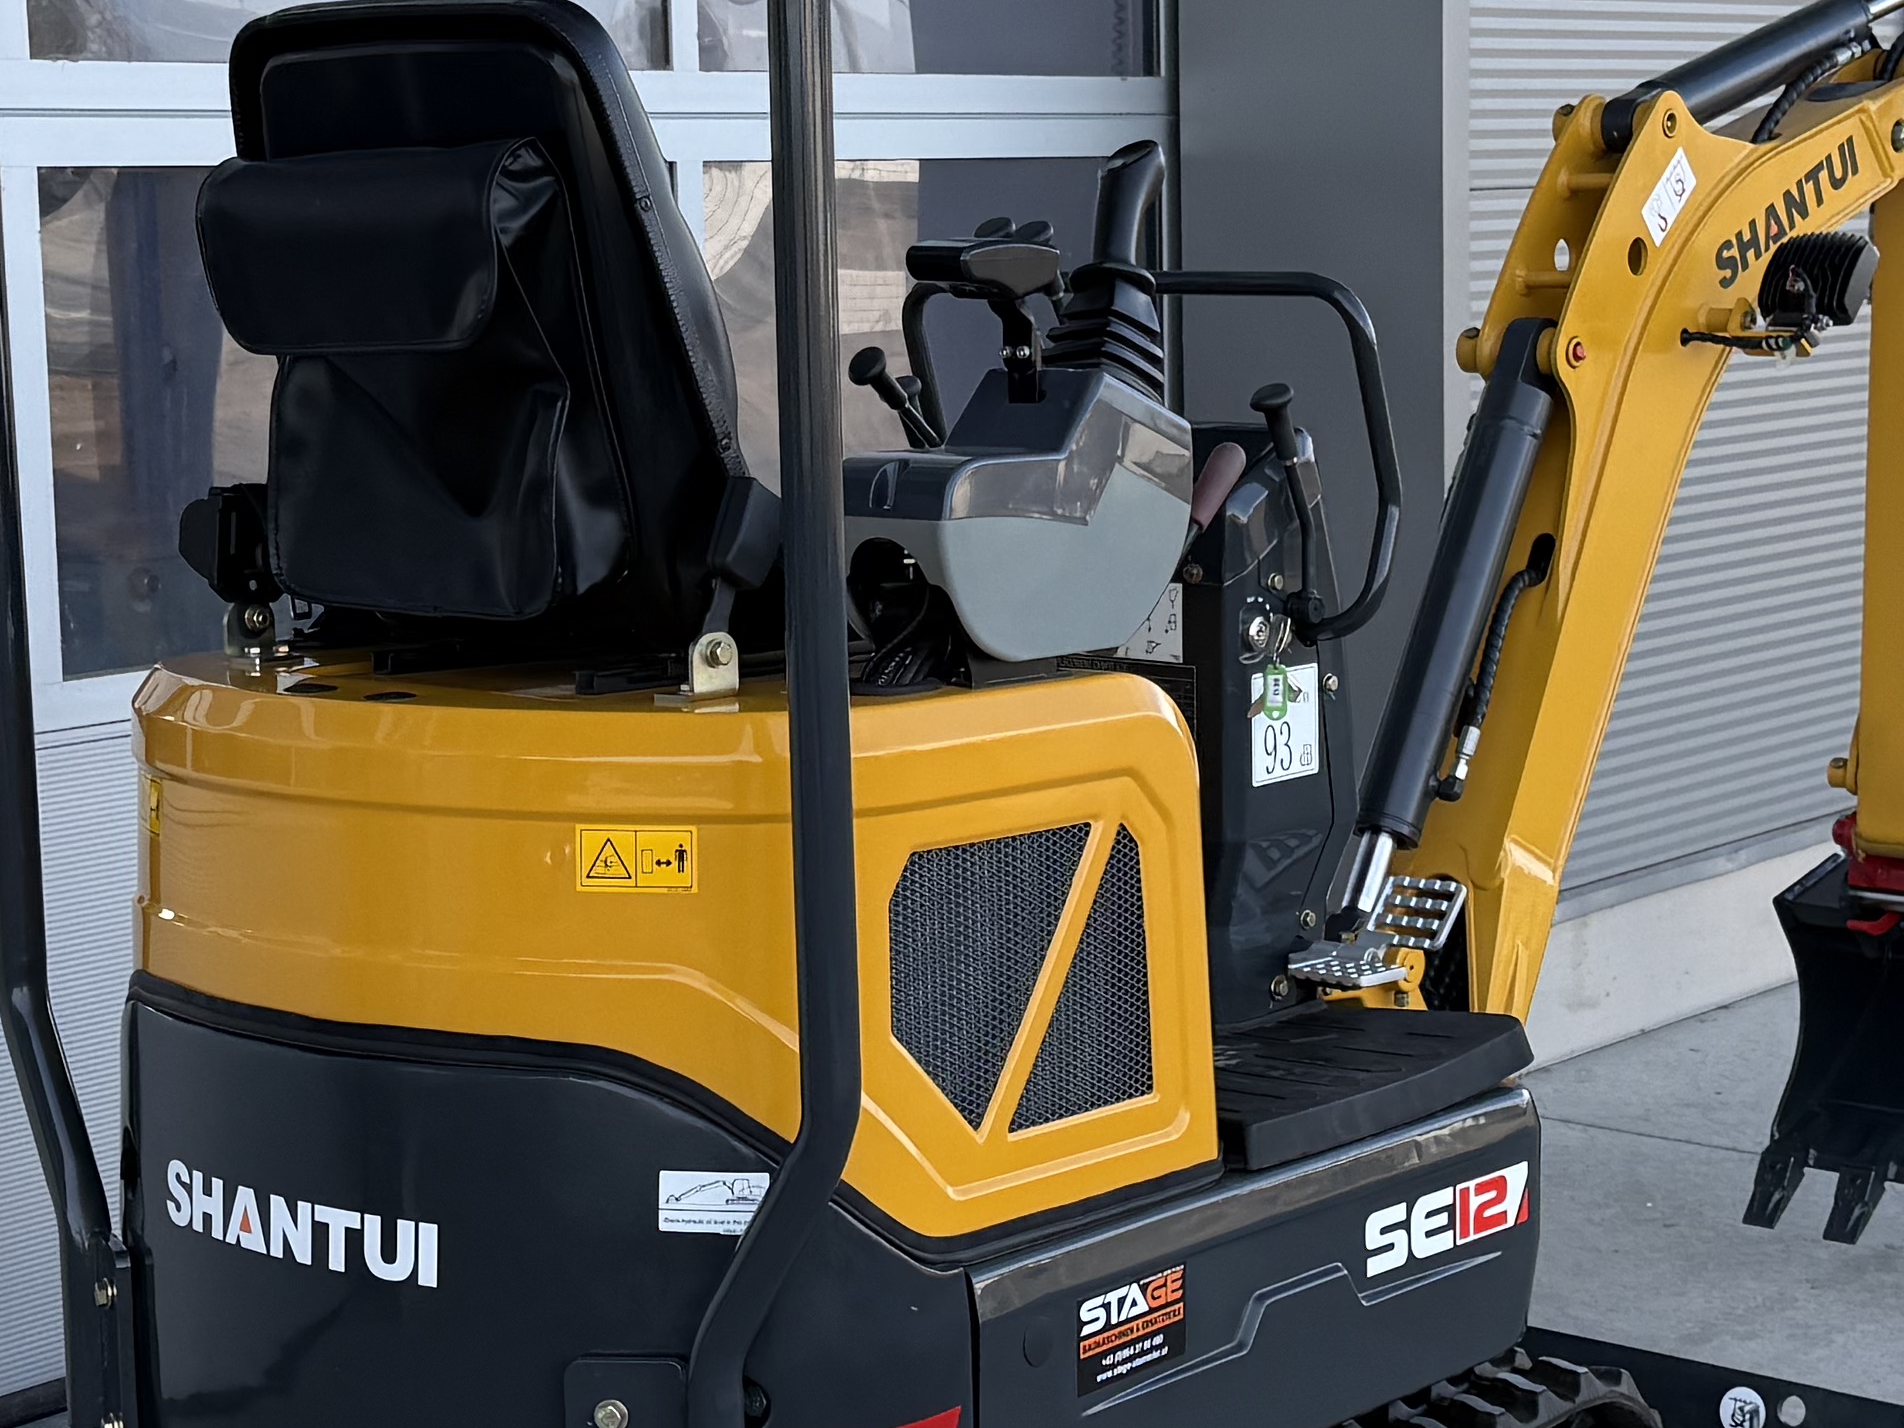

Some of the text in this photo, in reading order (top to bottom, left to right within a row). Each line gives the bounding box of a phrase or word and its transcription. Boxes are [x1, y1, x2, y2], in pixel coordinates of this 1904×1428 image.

[1715, 134, 1860, 291] SHANTUI
[1264, 721, 1293, 775] 93
[166, 1158, 439, 1288] SHANTUI
[1365, 1173, 1509, 1278] SE12
[1079, 1270, 1184, 1337] STAGE
